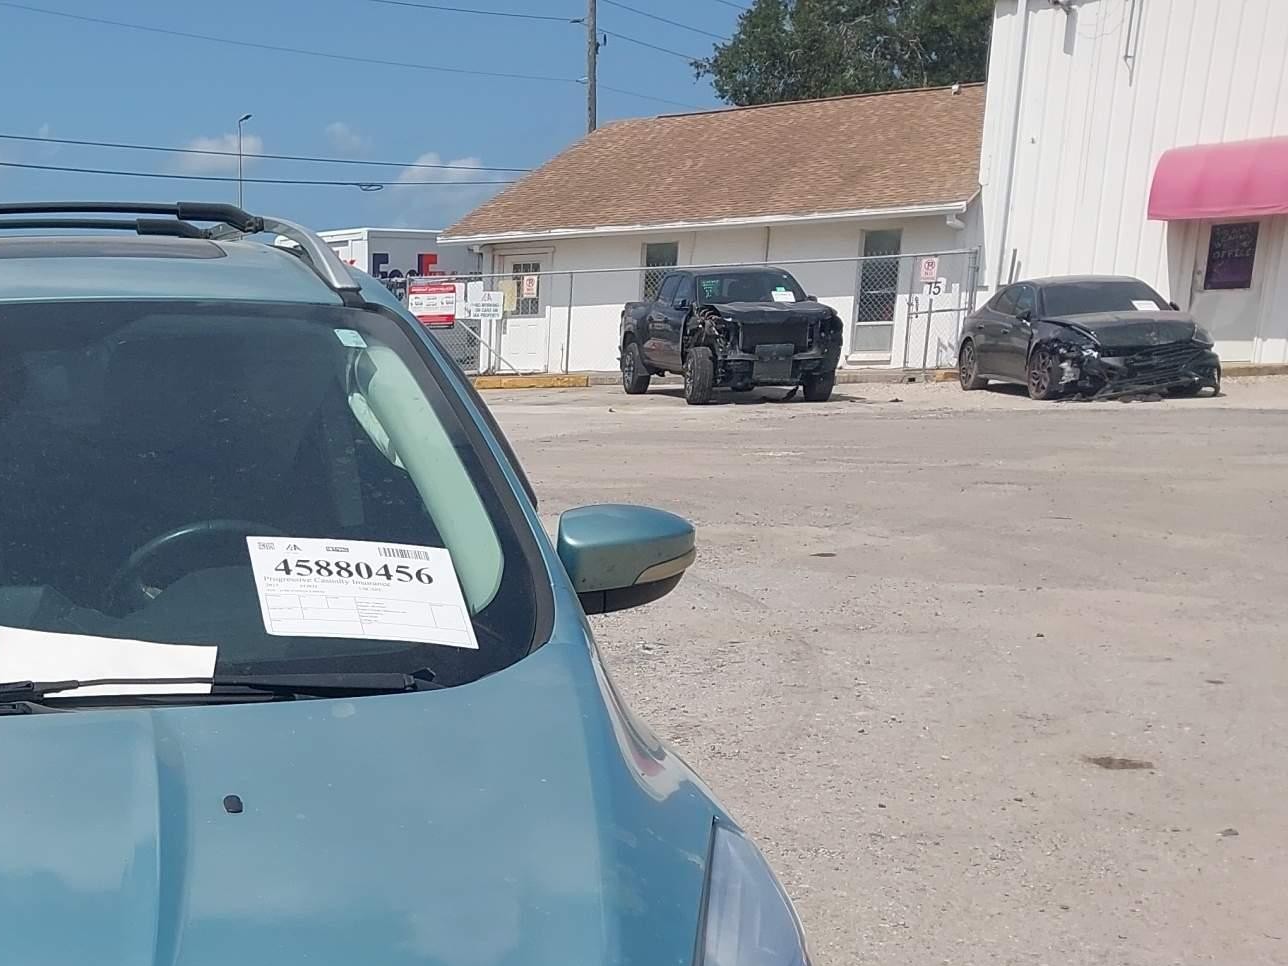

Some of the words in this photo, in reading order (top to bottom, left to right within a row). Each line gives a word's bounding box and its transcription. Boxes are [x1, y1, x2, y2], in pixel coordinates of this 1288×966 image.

[263, 575, 313, 585] Progressive
[313, 577, 350, 586] Casualty
[352, 578, 391, 587] Insurance
[274, 558, 434, 585] 45880456
